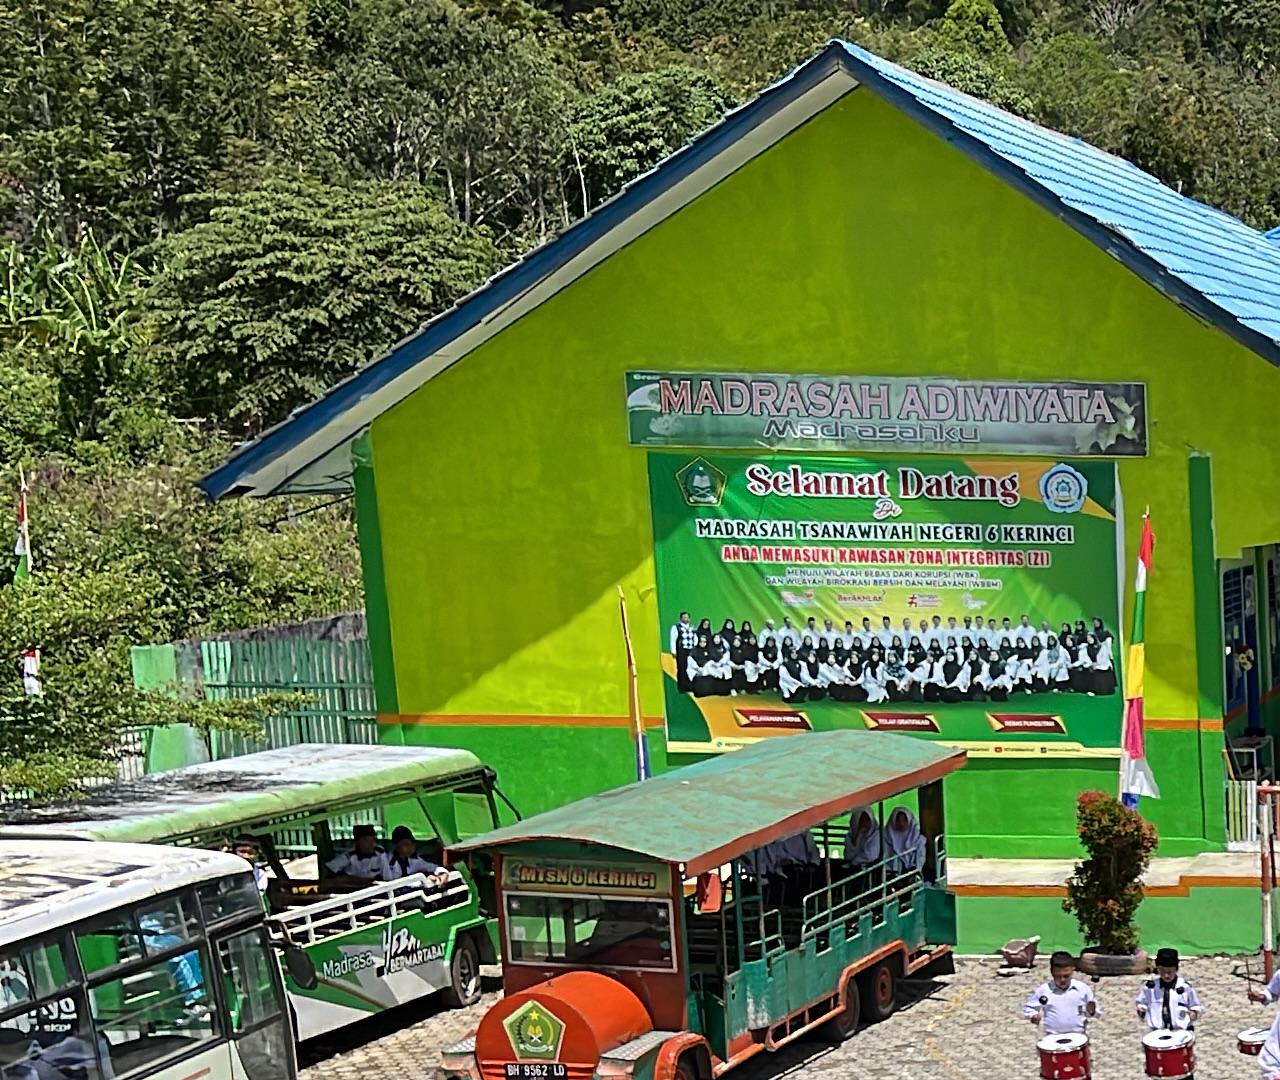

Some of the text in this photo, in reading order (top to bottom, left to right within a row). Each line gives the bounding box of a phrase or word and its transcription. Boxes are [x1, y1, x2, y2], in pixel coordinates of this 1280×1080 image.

[658, 378, 1116, 424] MADRASAH ADIWIYATA
[763, 418, 980, 443] Madrasahku
[746, 463, 1021, 507] Selamat Datang
[697, 519, 1073, 543] MADRASAH TSANAWIYAH NEGERI 6 KERINCI
[723, 545, 759, 561] ANDA
[762, 547, 835, 562] MEMASUKI
[838, 549, 905, 564] KAWASAN
[908, 550, 943, 565] ZONA
[947, 551, 1025, 566] INTEGRITAS
[766, 577, 784, 585] DAN
[786, 577, 824, 585] WILAYAH
[826, 578, 871, 586] BIROKRASI
[905, 579, 923, 587] DAN
[925, 580, 968, 588] MELAYANI
[892, 570, 913, 578] DARI
[915, 570, 951, 579] KORUPSI
[586, 869, 656, 889] KERINCI
[507, 1064, 565, 1076] BH 9562 LD
